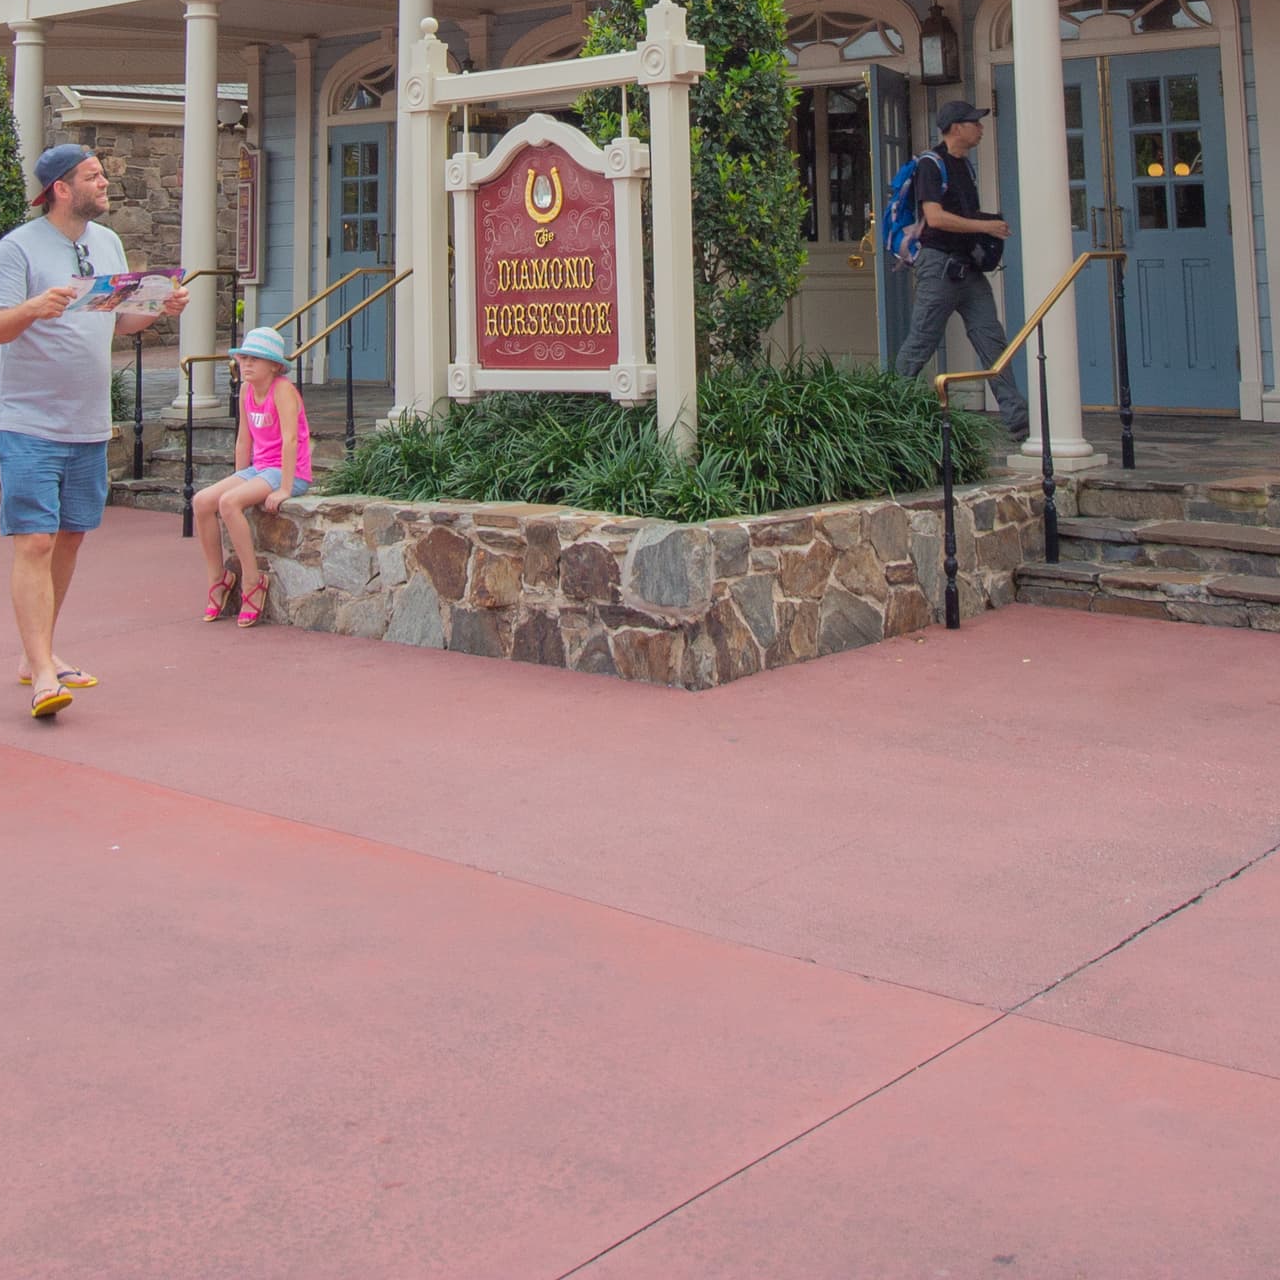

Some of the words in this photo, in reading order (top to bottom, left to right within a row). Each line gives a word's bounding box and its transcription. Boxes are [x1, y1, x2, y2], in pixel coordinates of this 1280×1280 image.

[533, 226, 555, 248] The
[496, 255, 596, 292] DIAMOND
[484, 301, 612, 337] HORSESHOE
